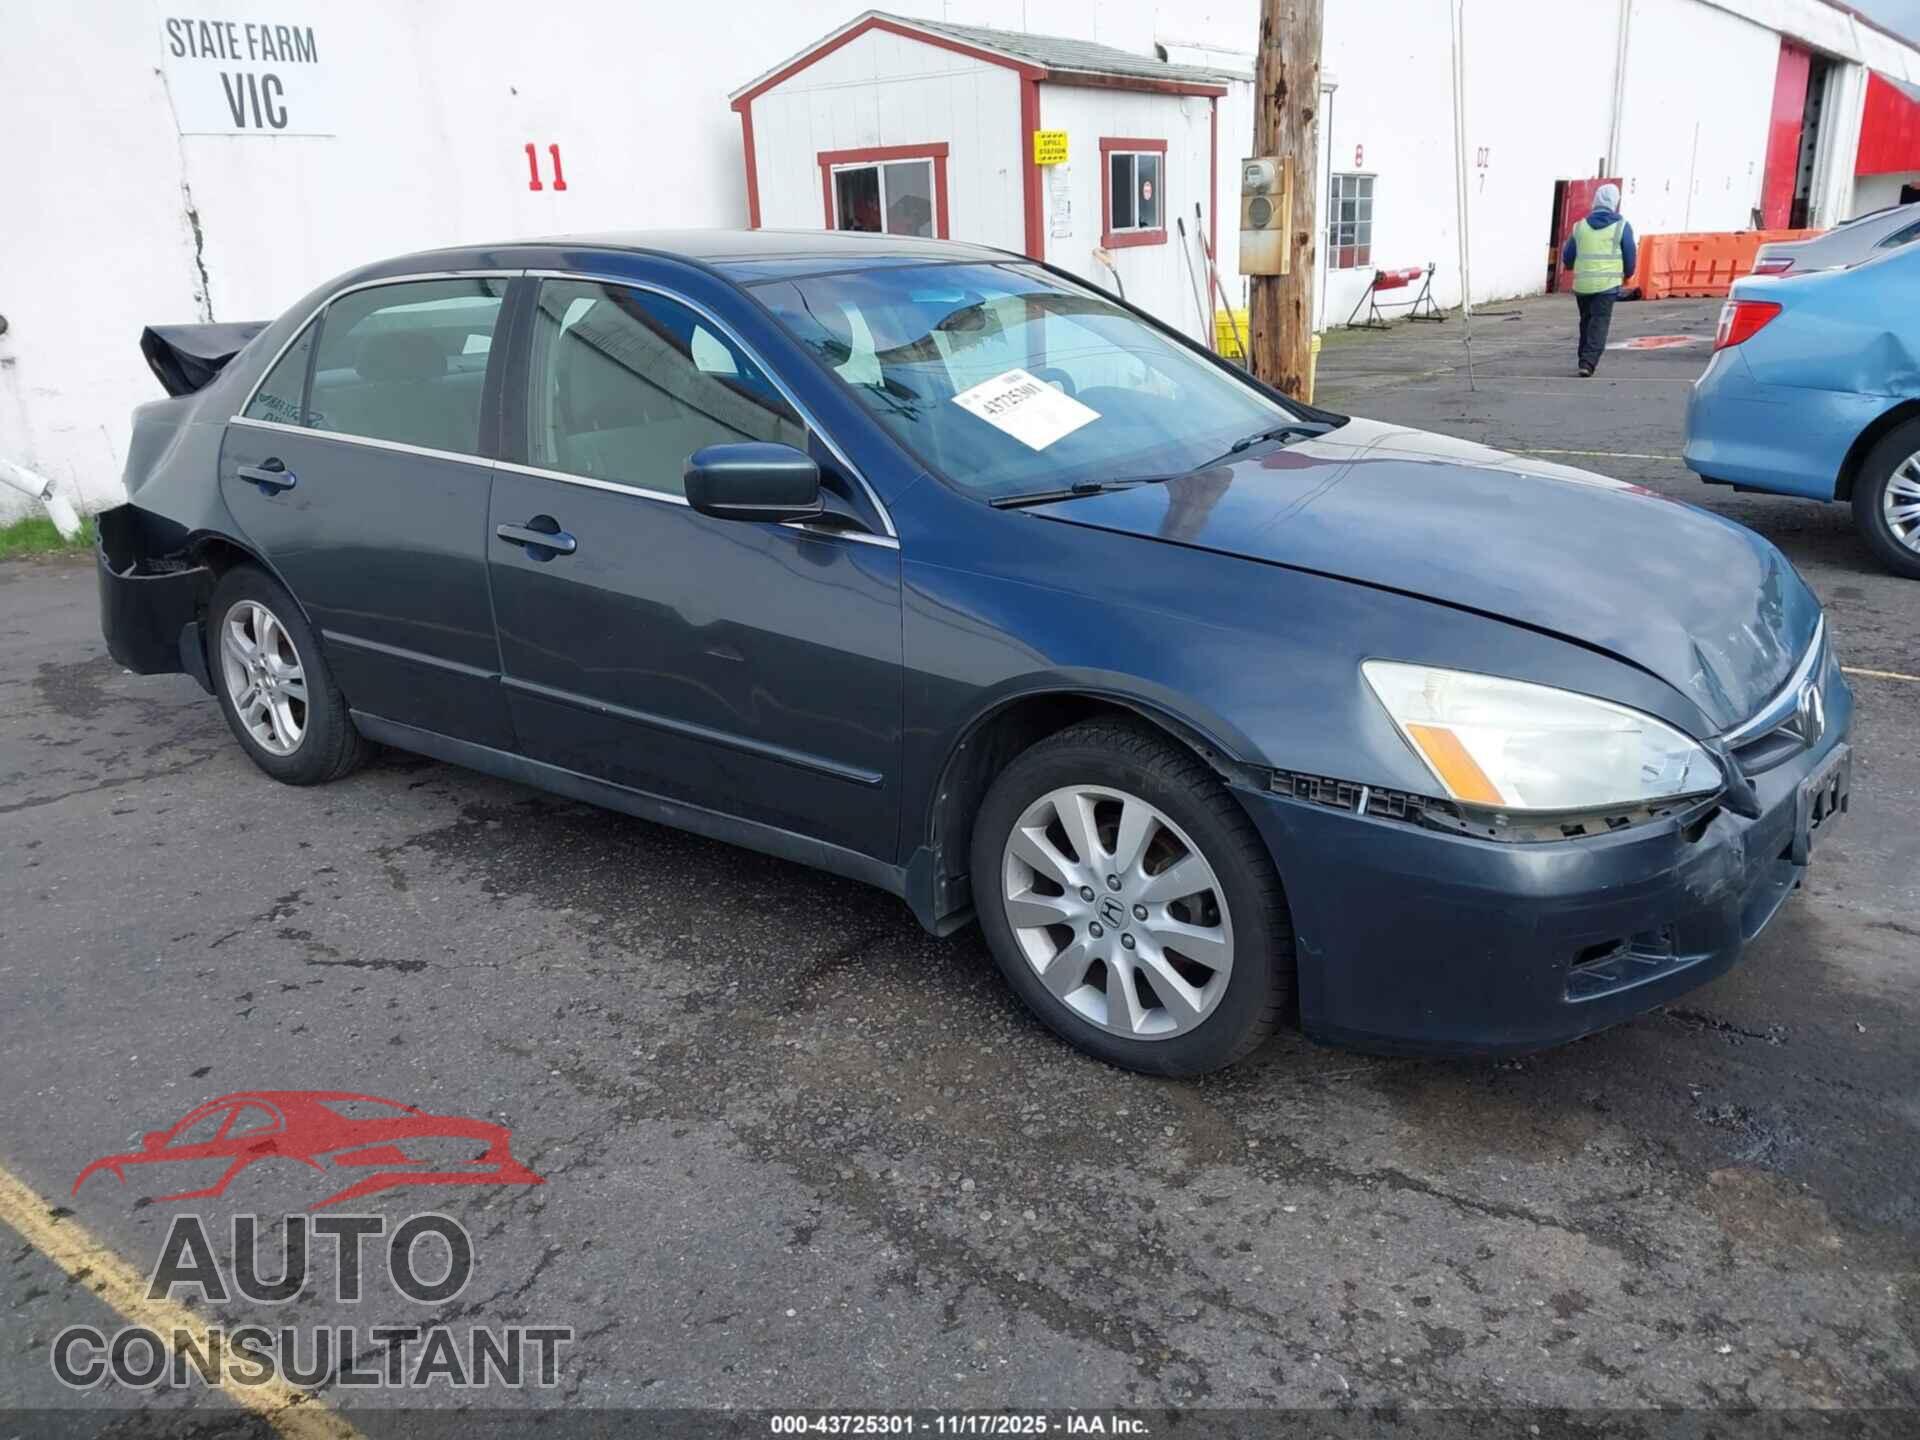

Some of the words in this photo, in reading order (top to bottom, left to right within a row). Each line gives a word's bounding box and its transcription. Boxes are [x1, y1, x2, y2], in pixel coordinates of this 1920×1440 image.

[166, 18, 242, 60] STATE
[245, 23, 318, 63] FARM
[220, 72, 289, 129] VIC
[525, 143, 567, 191] 11
[1355, 144, 1362, 167] 8
